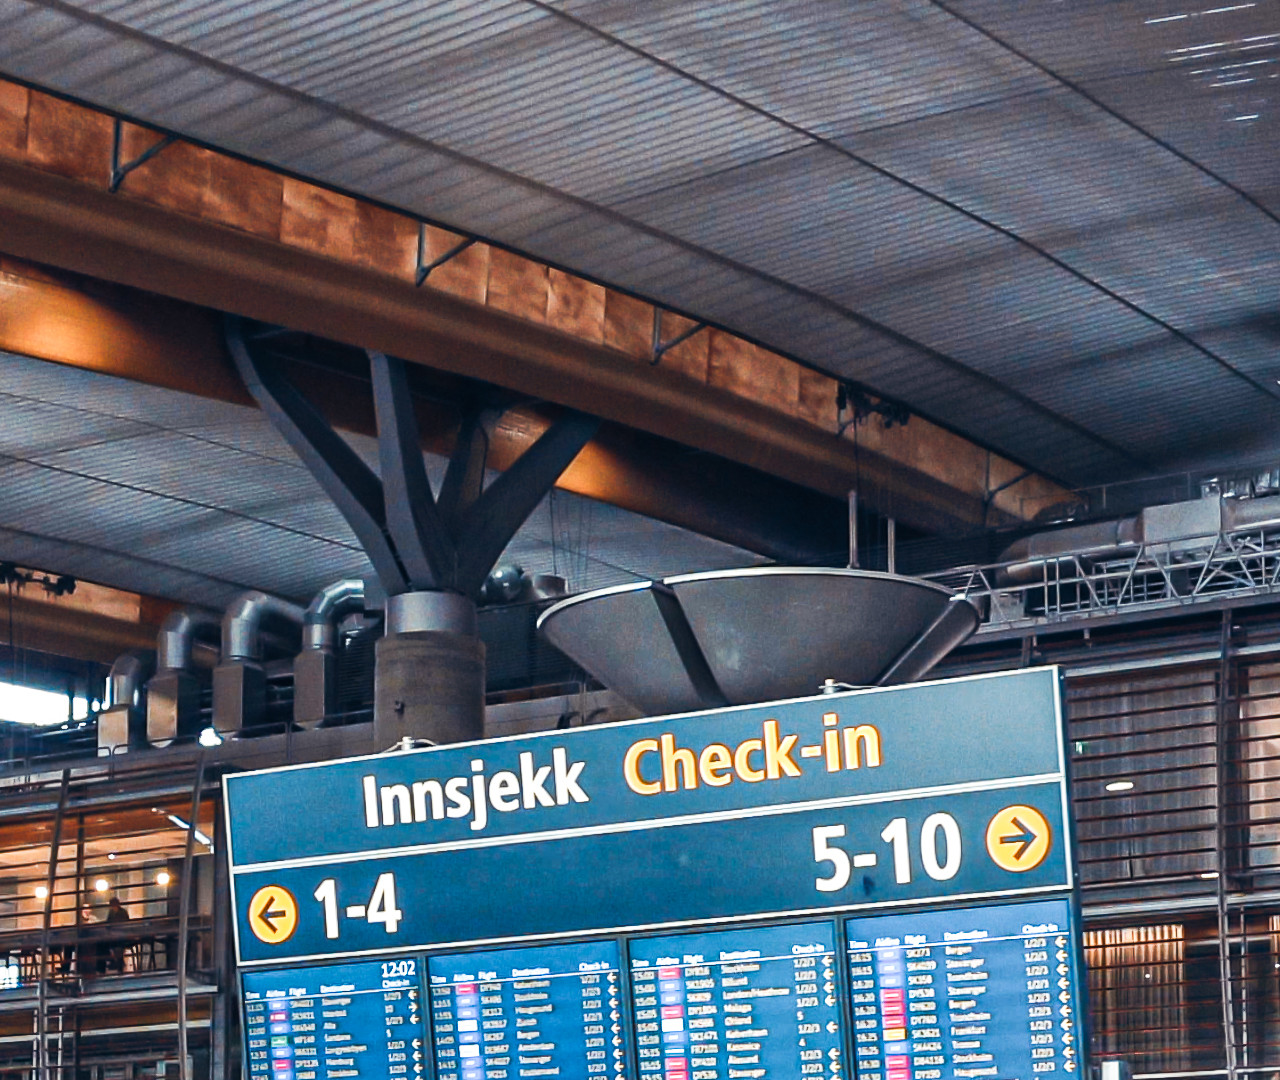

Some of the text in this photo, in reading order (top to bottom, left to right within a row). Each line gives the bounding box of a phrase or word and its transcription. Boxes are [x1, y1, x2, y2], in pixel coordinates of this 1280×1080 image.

[362, 715, 882, 830] Innsjekk Check-in
[812, 812, 962, 891] 5-10
[314, 872, 402, 938] 1-4
[381, 961, 415, 977] 12:02
